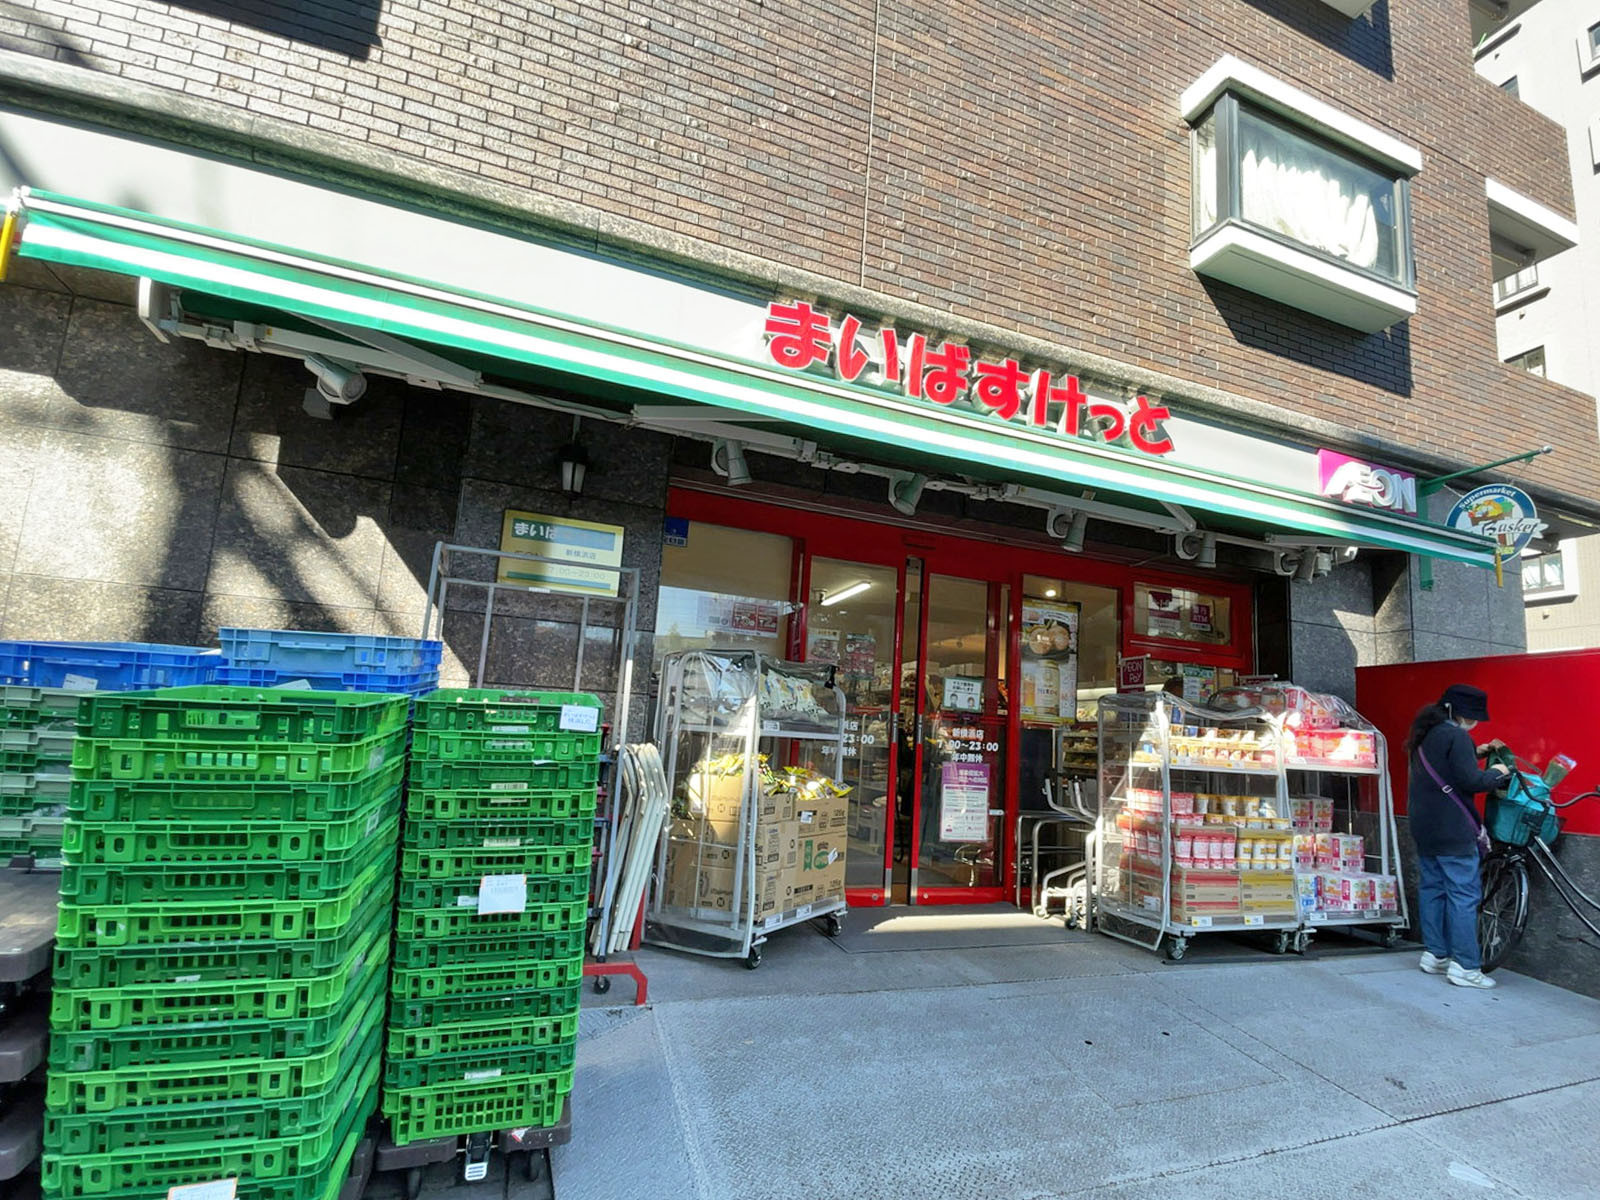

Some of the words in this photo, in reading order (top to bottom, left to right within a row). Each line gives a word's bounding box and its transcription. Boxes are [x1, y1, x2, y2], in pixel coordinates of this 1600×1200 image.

[765, 300, 1175, 456] まいばすけっと
[1458, 487, 1516, 510] Supermarket
